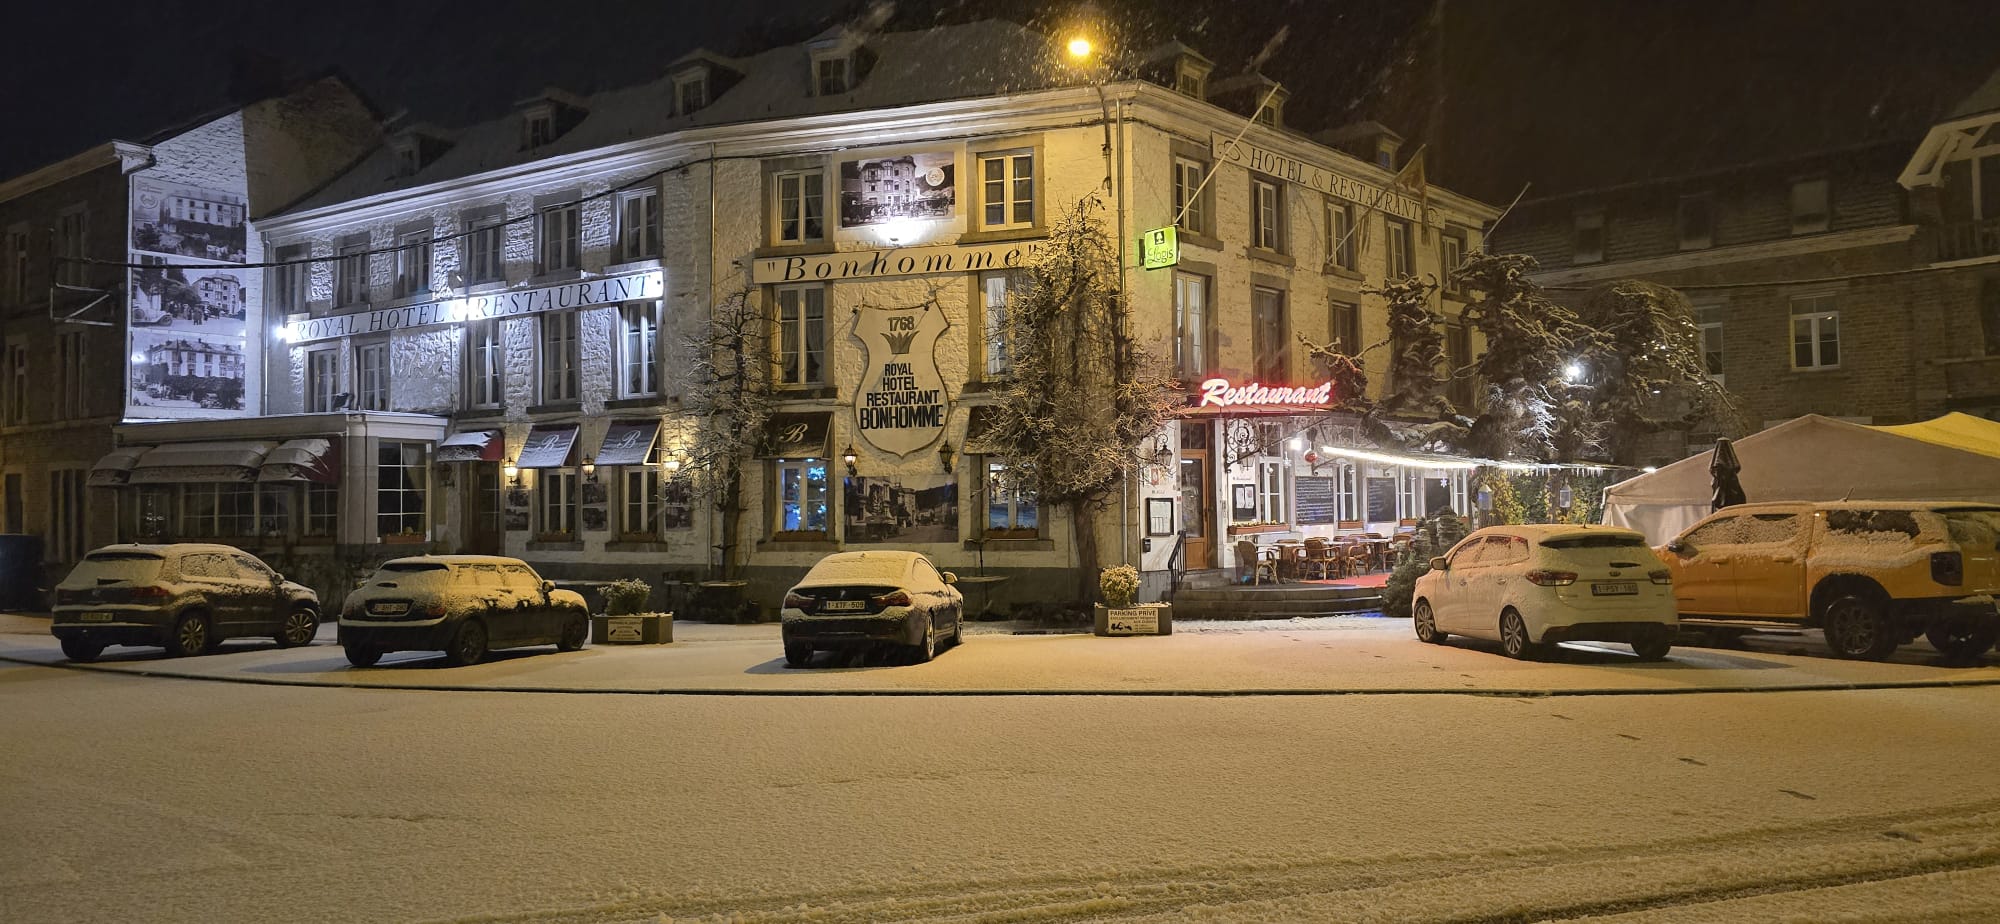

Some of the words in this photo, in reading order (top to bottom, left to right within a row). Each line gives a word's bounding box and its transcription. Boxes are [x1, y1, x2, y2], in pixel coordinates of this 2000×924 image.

[1250, 148, 1307, 184] HOTEL
[1312, 169, 1323, 189] &
[1330, 174, 1421, 220] RESTAURANT
[1147, 247, 1174, 264] Logis
[475, 274, 652, 317] RESTAURANT
[296, 315, 360, 341] ROYAL
[368, 303, 445, 332] HOTEL
[888, 316, 915, 331] 1768
[884, 363, 914, 376] ROYAL
[882, 376, 919, 391] HOTEL
[1201, 378, 1332, 407] Restaurant
[866, 389, 940, 407] RESTAURANT
[860, 405, 944, 430] BONHOMME
[780, 423, 809, 442] B
